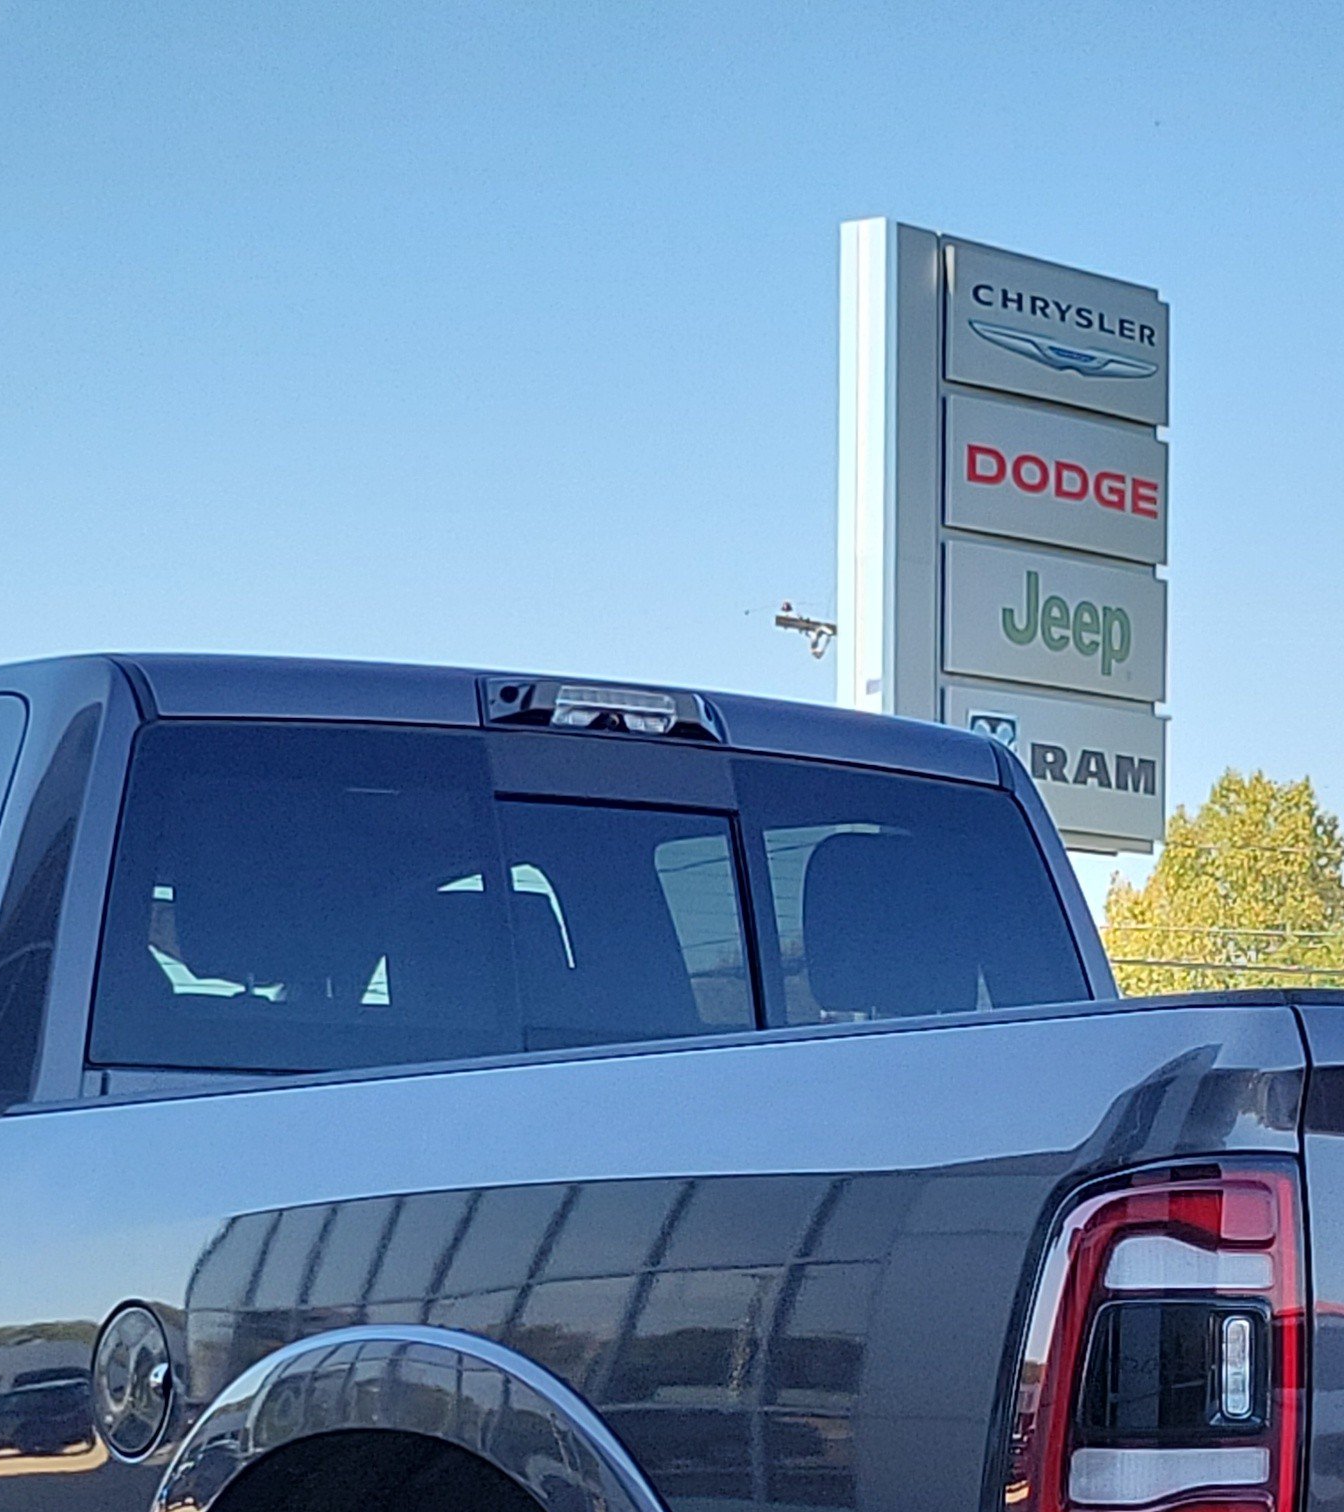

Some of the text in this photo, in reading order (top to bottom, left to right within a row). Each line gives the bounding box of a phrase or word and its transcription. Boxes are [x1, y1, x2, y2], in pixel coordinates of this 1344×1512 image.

[972, 284, 1156, 347] CHRYSLER
[966, 443, 1159, 519] DODGE
[1002, 570, 1132, 676] Jeep
[1031, 742, 1156, 796] RAM
